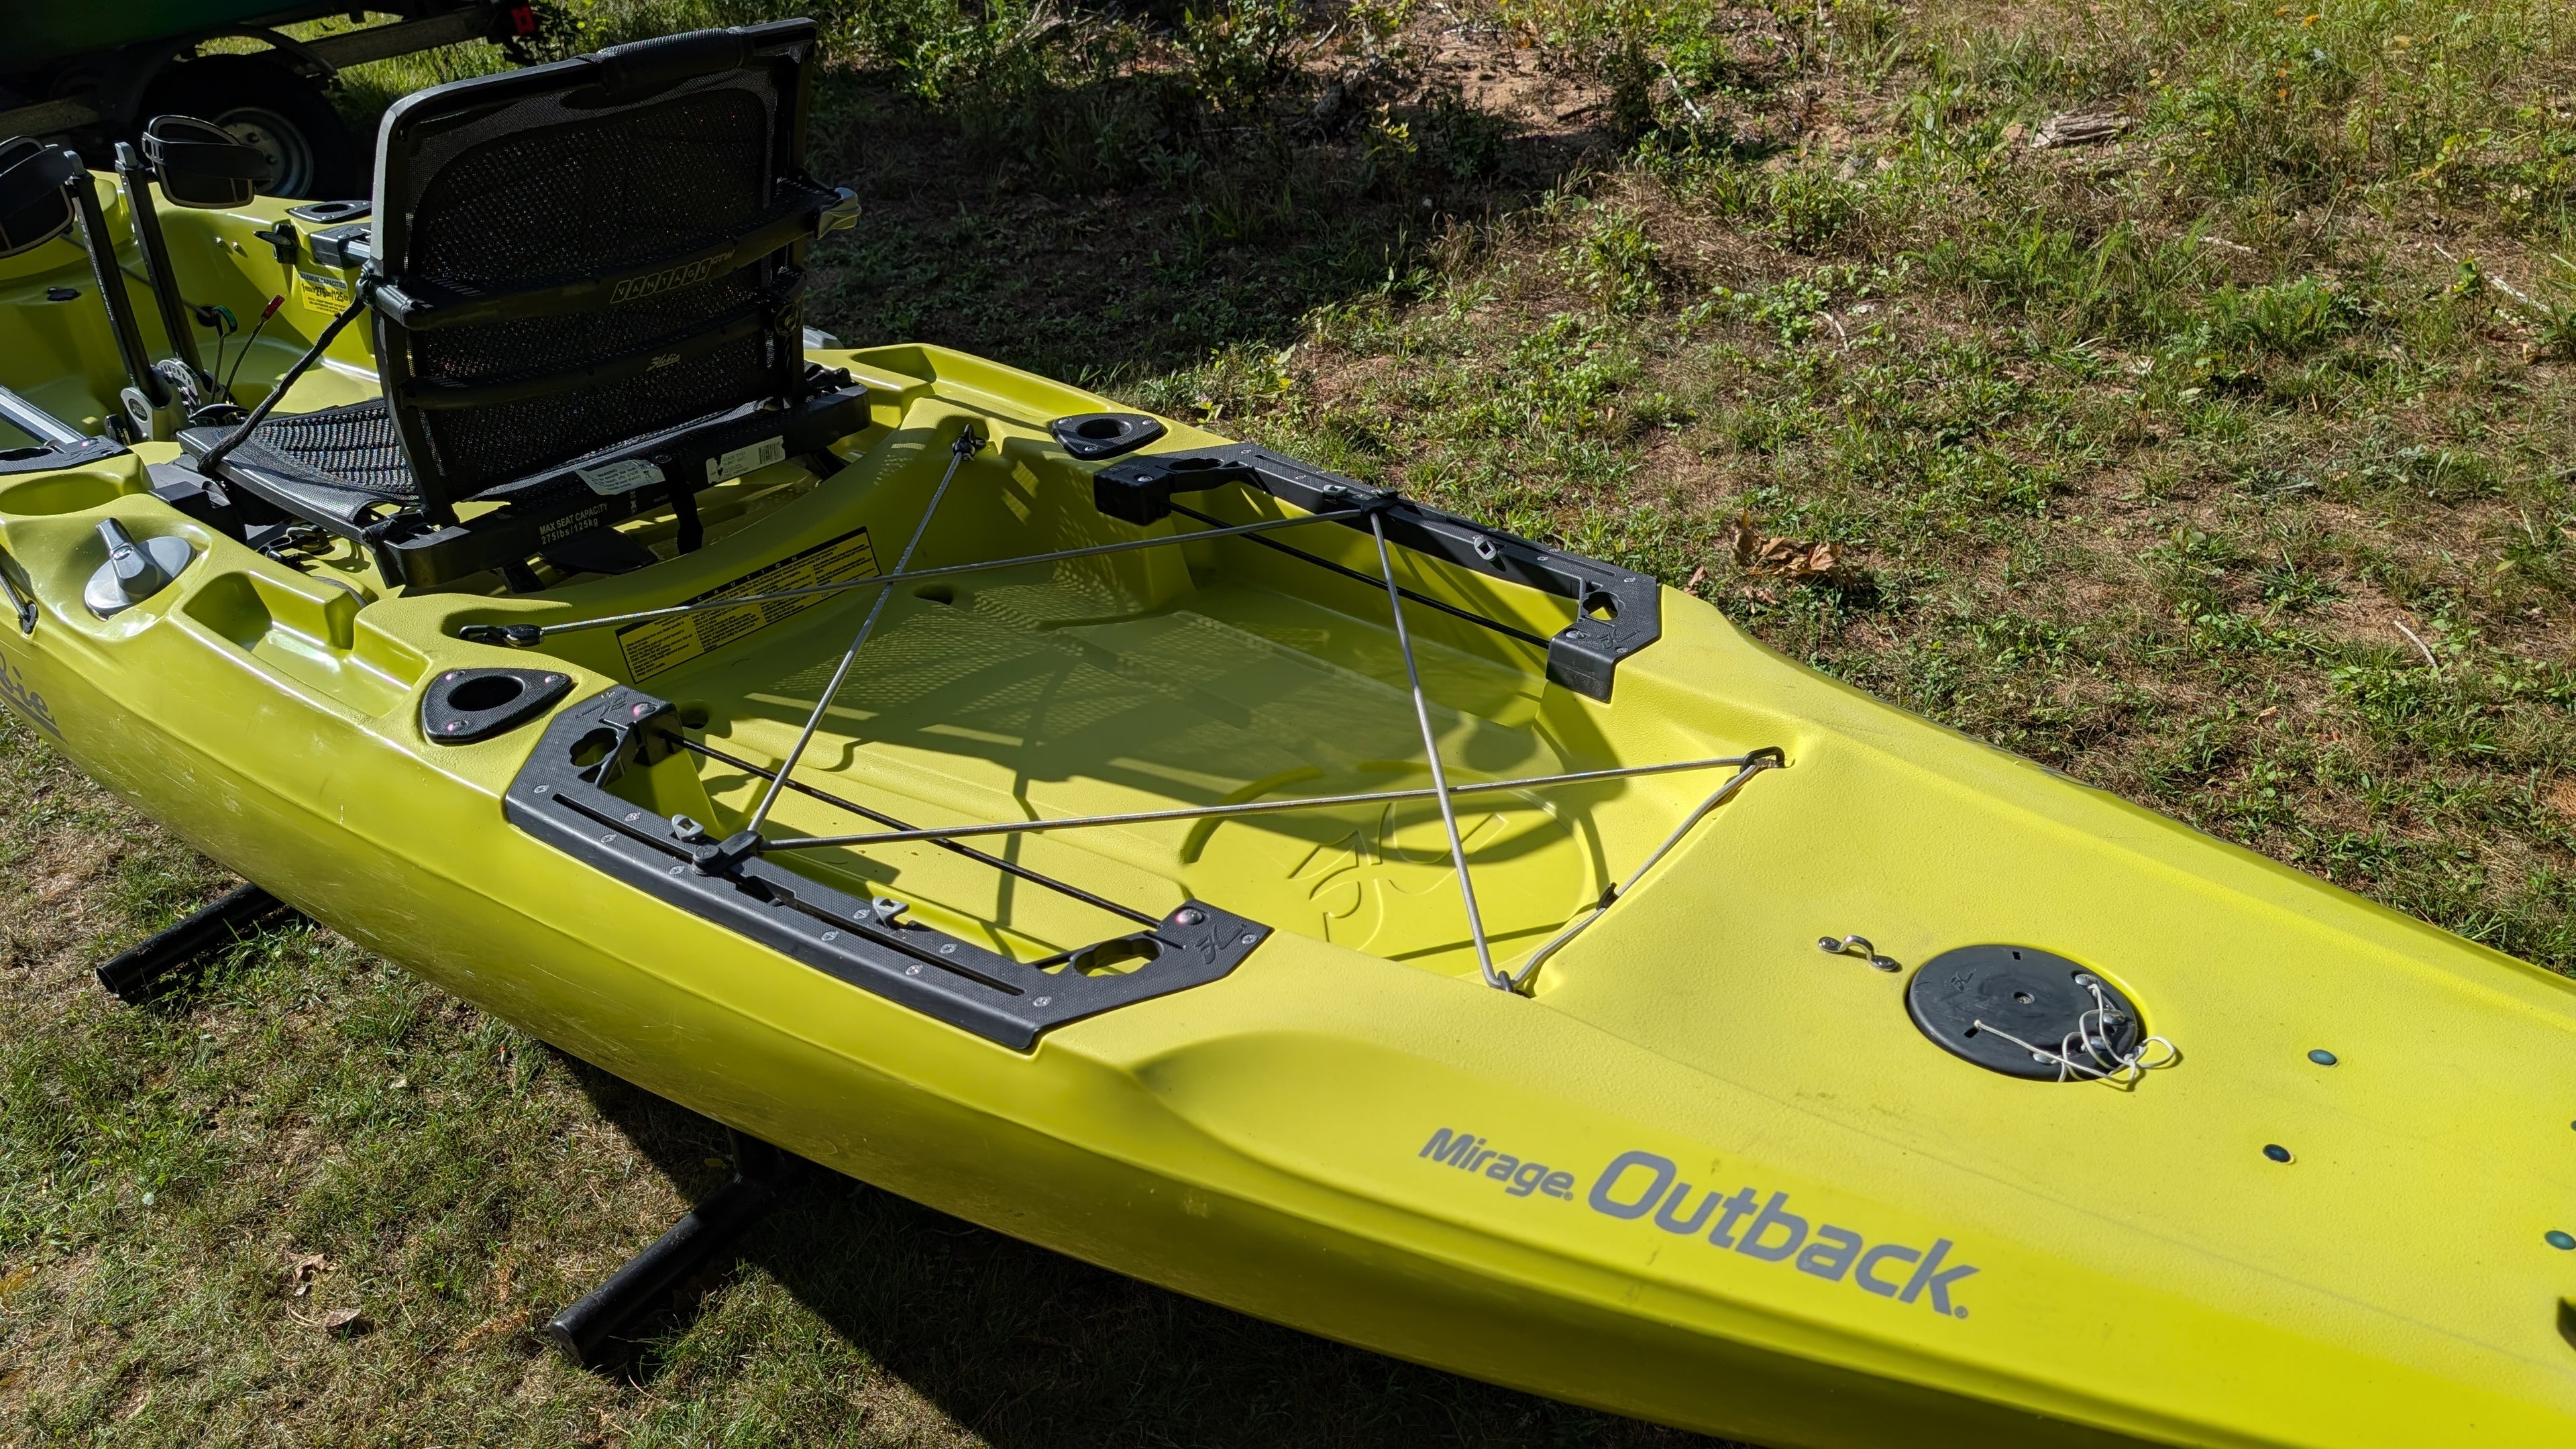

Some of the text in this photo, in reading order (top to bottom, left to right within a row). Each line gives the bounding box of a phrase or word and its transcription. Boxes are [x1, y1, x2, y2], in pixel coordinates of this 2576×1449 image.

[614, 261, 709, 299] VANTAGE
[645, 353, 680, 372] Hobie
[596, 468, 618, 478] WARNING
[539, 502, 608, 535] MAX SEAT CAPACITY
[696, 555, 798, 602] CAUTION
